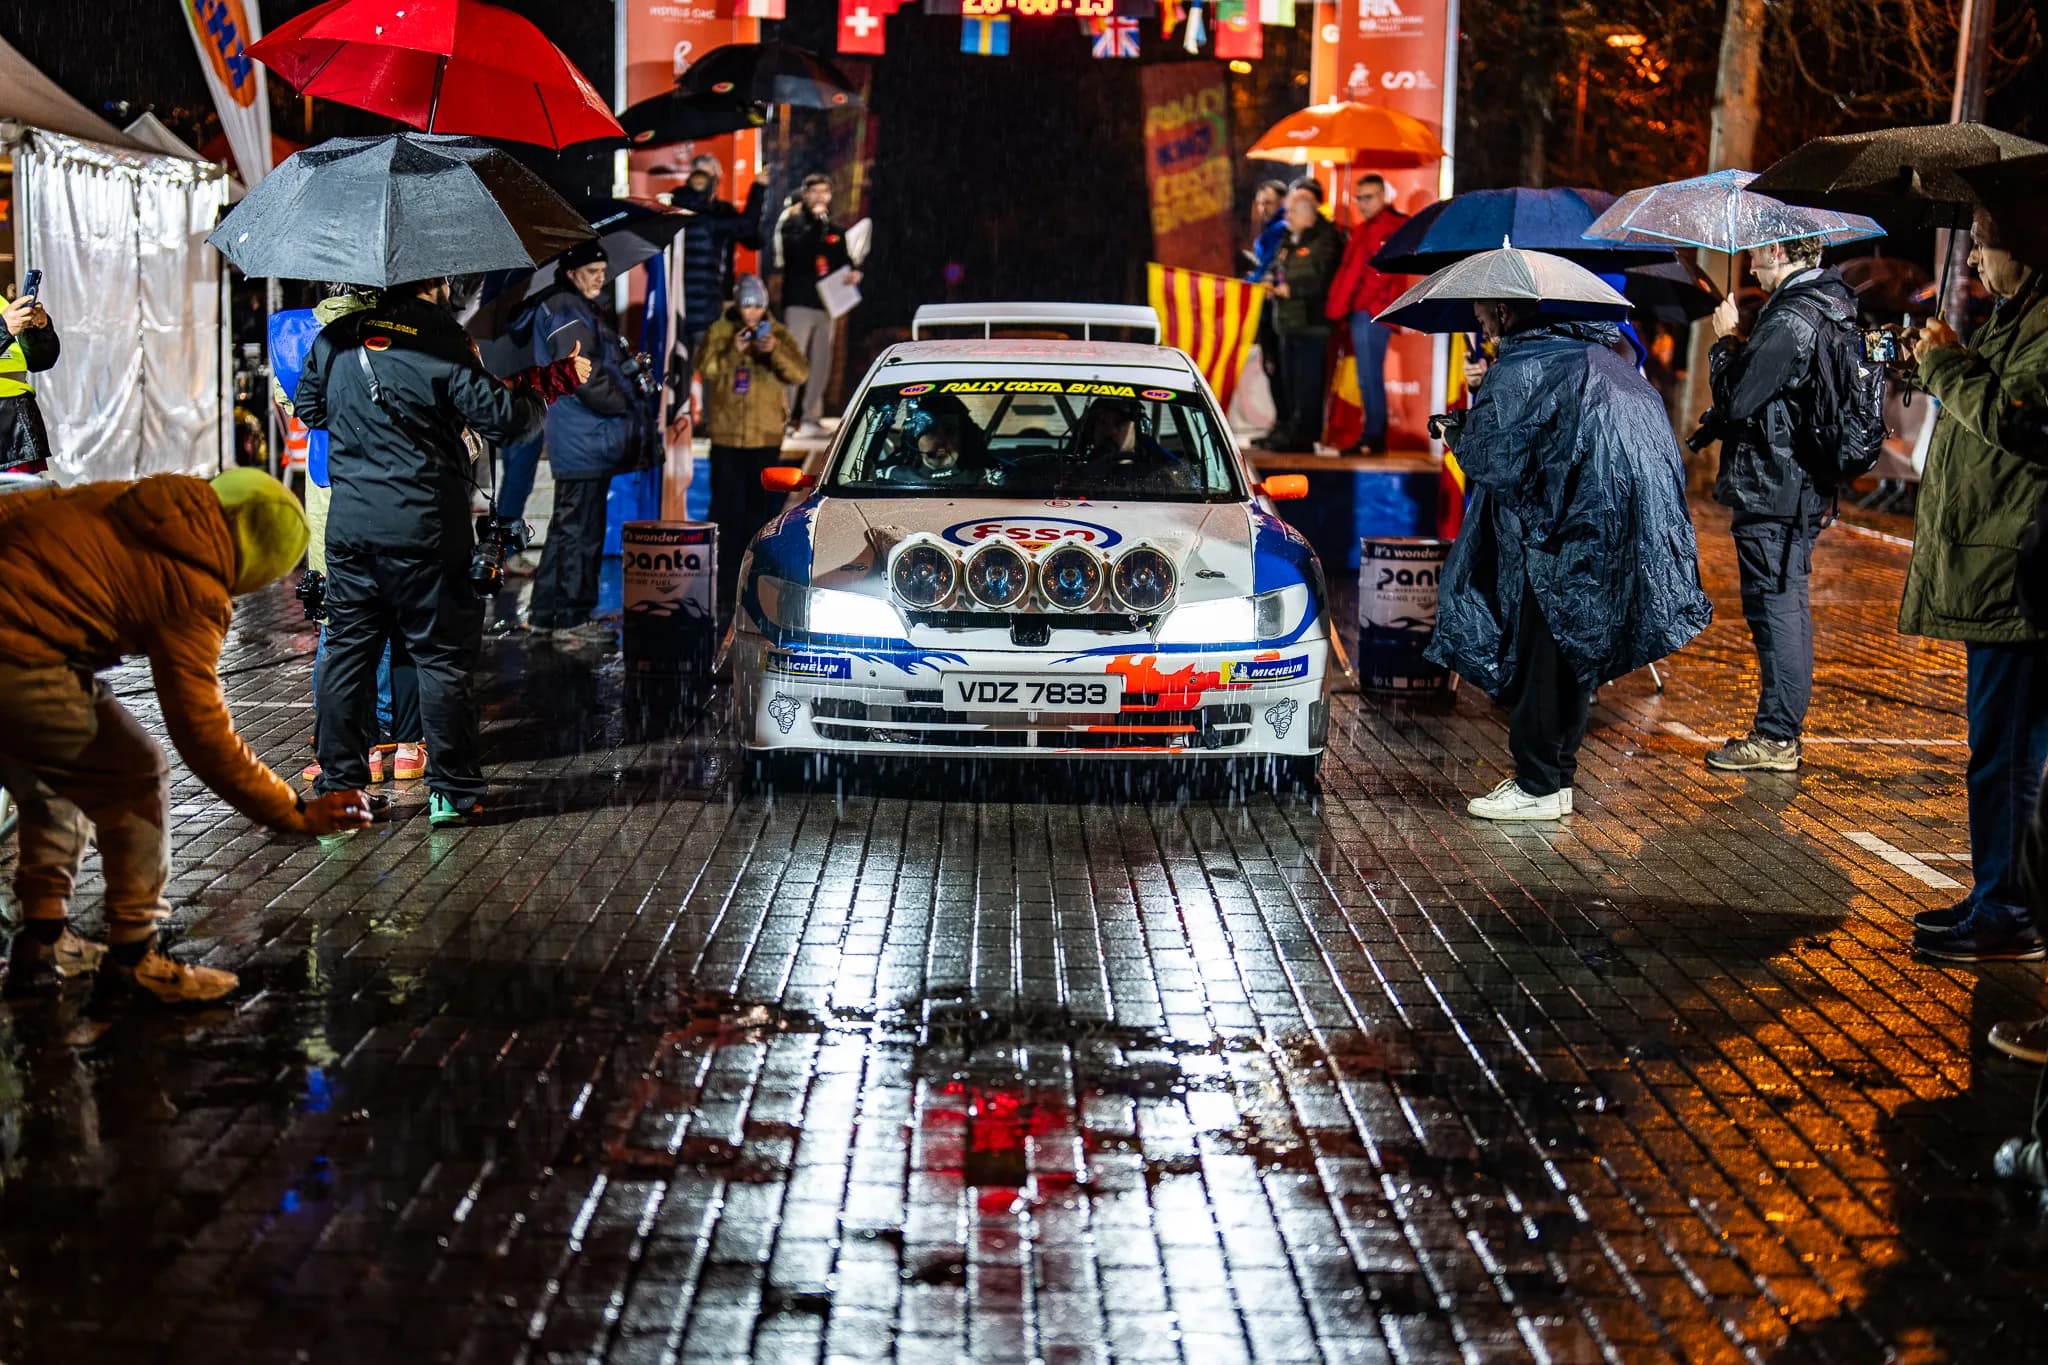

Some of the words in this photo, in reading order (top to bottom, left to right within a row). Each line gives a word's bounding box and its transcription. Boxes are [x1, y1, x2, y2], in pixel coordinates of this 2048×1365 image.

[940, 382, 1004, 393] RALLY
[1004, 382, 1064, 393] COSTA
[1066, 383, 1136, 397] BRAVA
[1376, 565, 1441, 590] pant
[780, 660, 839, 672] MICHELIN
[1251, 664, 1302, 677] MICHELIN
[958, 681, 1018, 703] VDZ
[1026, 683, 1107, 705] 7833
